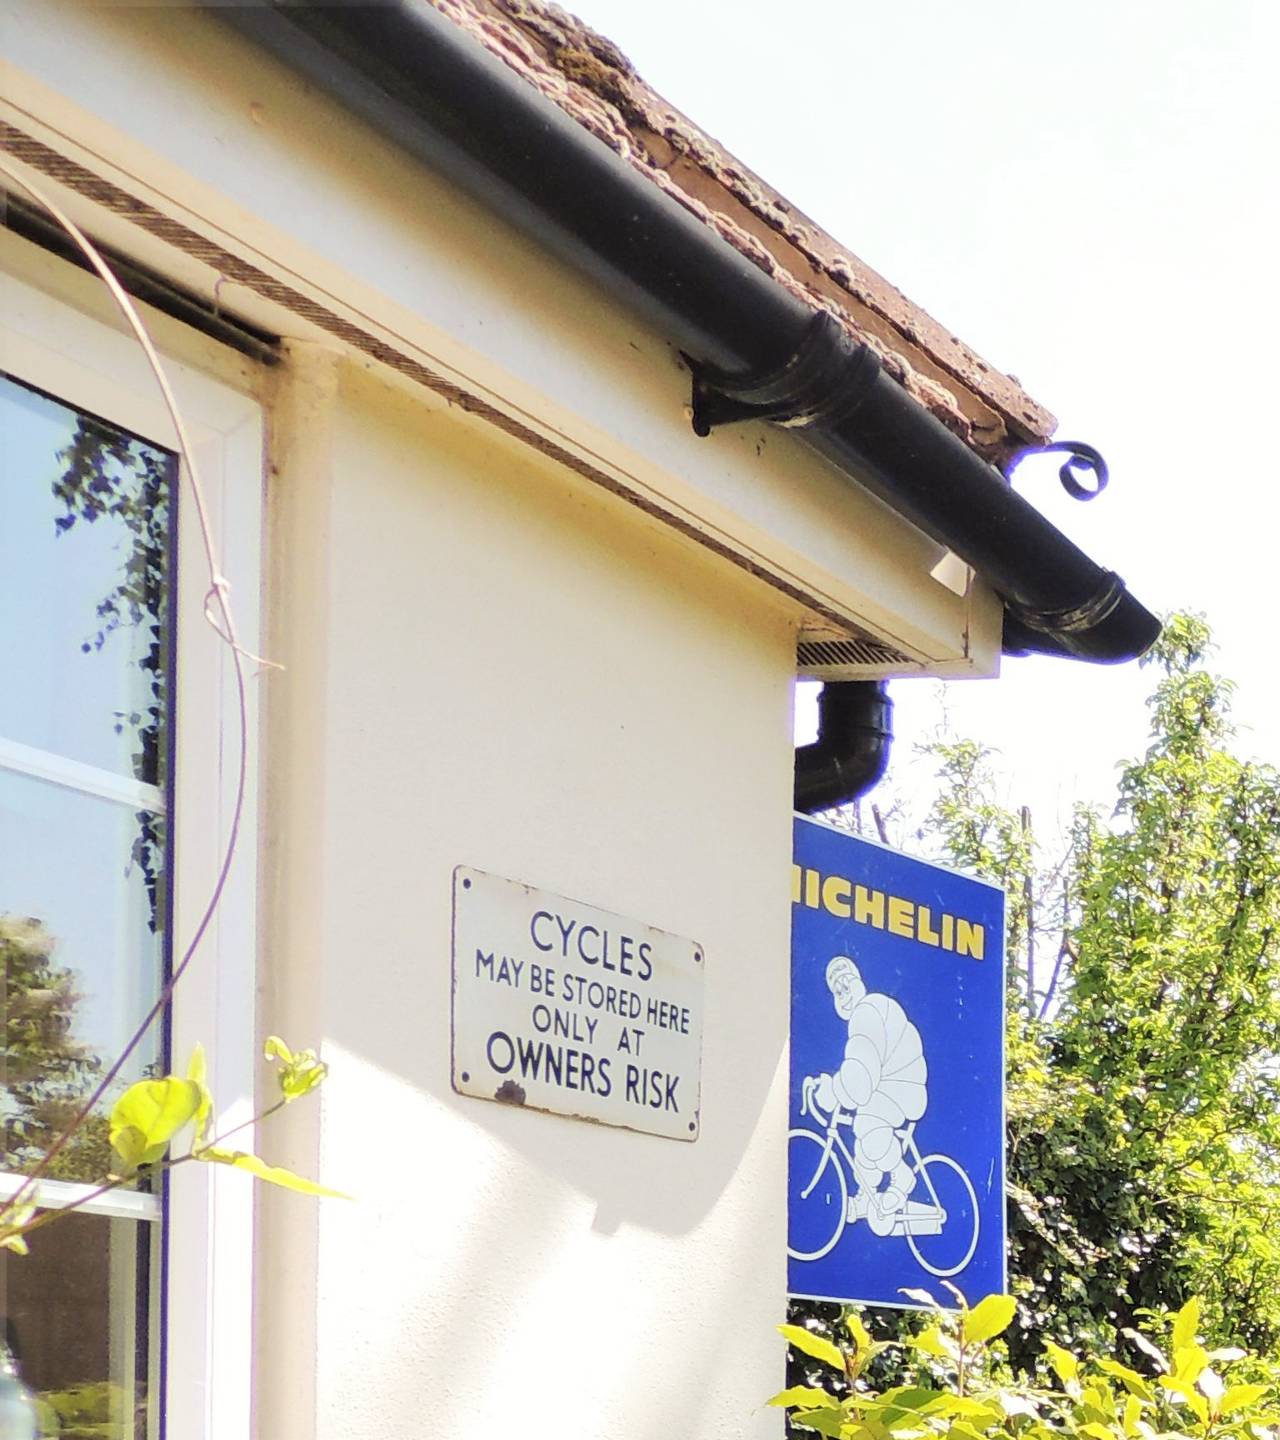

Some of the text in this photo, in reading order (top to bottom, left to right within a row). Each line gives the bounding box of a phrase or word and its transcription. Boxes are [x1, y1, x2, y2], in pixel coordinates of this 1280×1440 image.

[531, 911, 652, 981] CYCLES
[475, 948, 690, 1034] MAY BE STORED HERE
[532, 1004, 645, 1056] ONLY AT
[486, 1031, 680, 1113] OWNERS RISK
